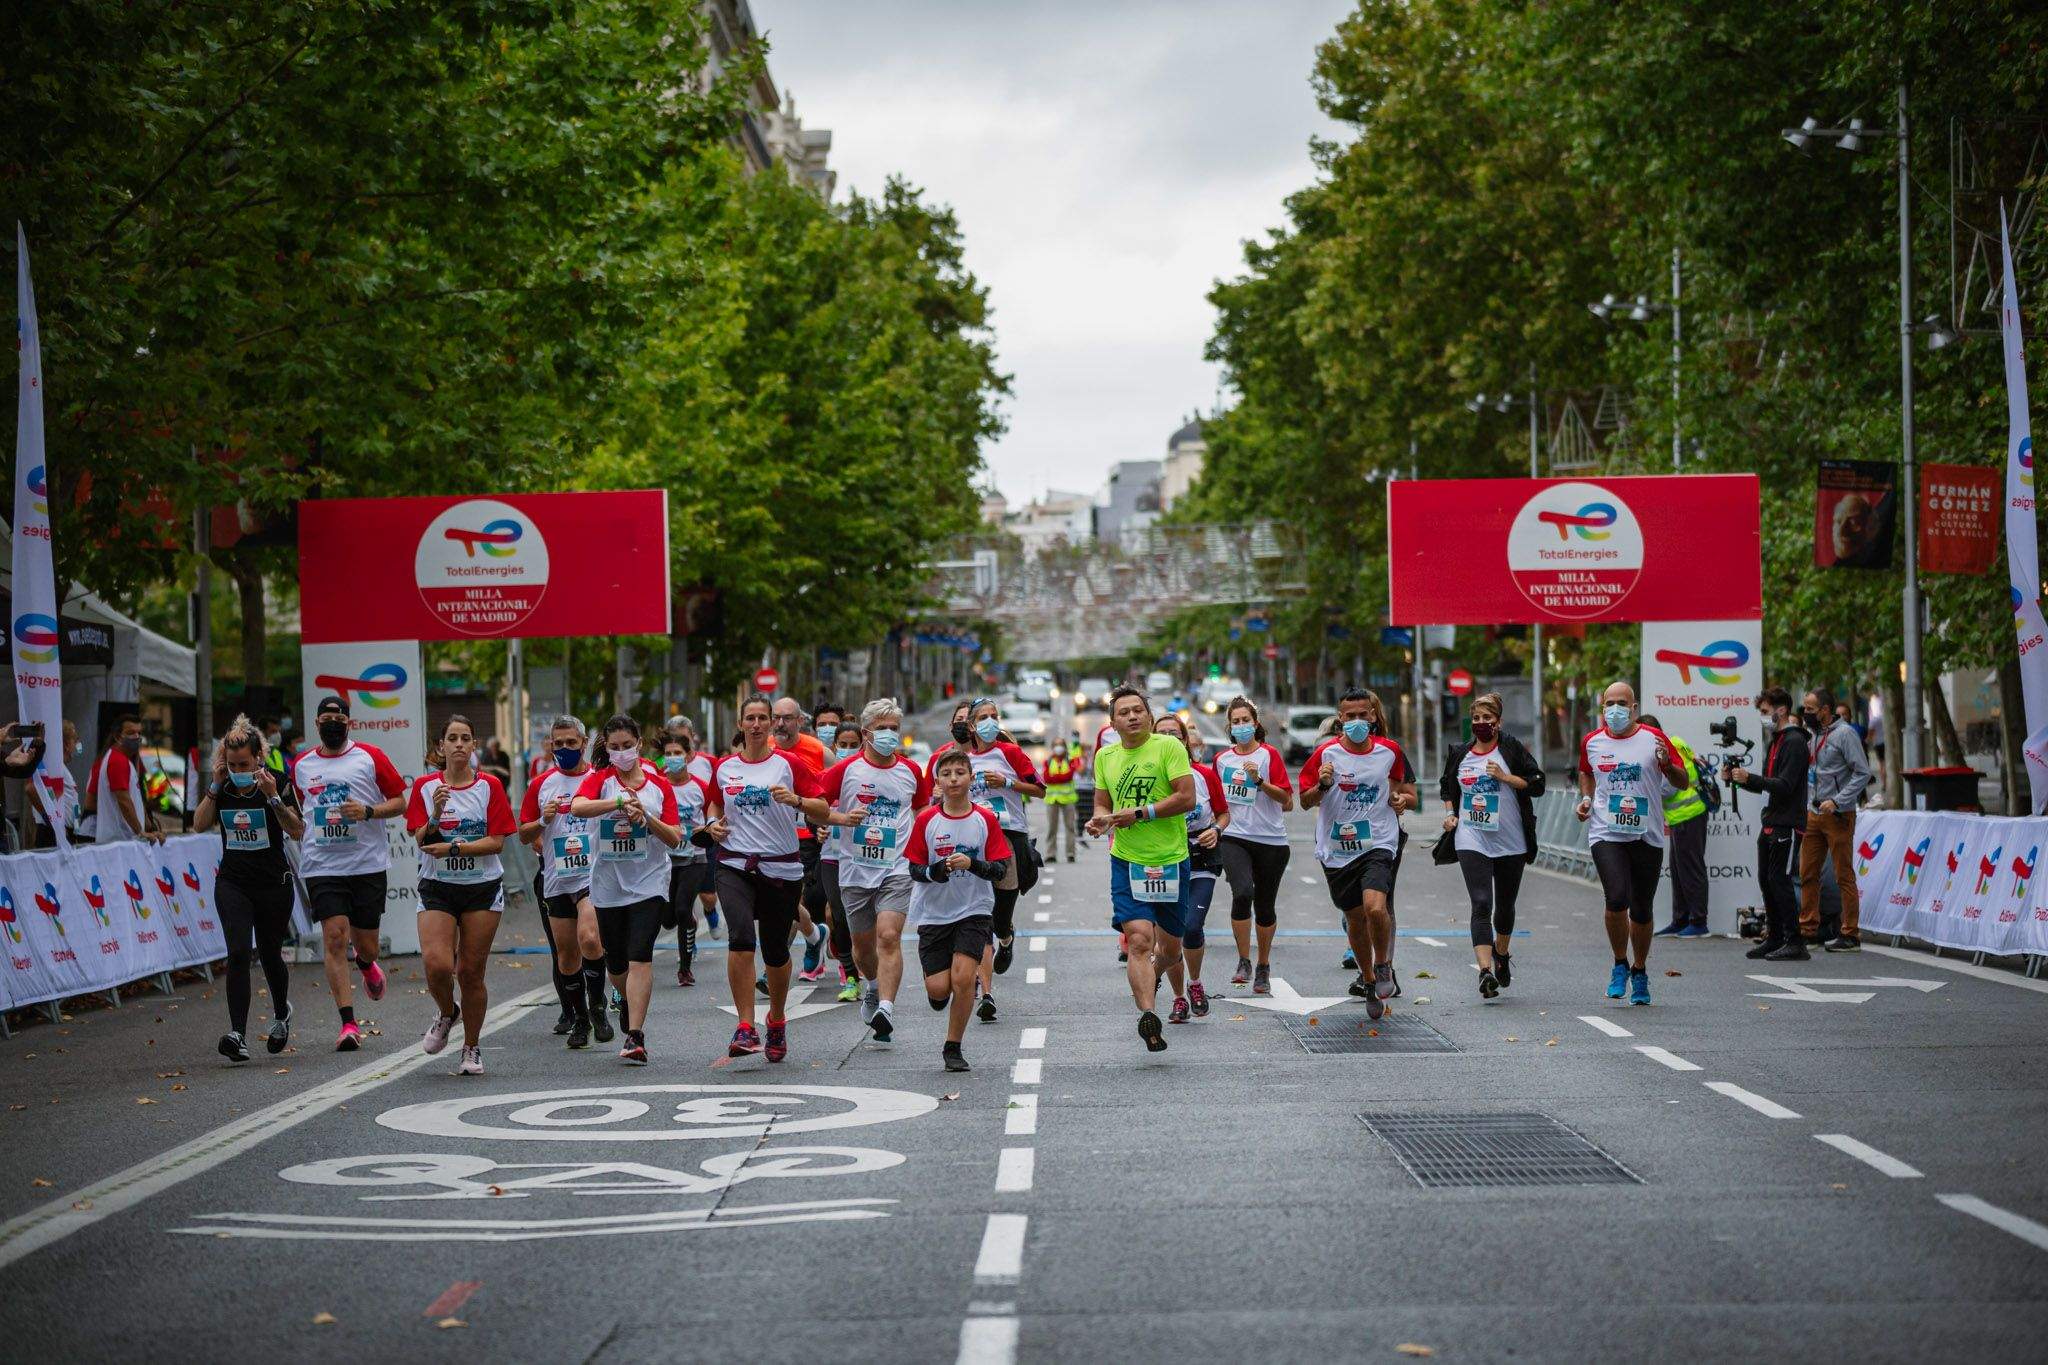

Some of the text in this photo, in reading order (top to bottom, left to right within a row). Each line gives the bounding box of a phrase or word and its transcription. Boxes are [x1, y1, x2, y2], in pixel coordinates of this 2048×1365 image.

[1538, 549, 1619, 561] TotalEnergies
[445, 565, 525, 577] TotalEnergies
[1558, 572, 1596, 583] MILLA
[465, 589, 502, 600] MILLA
[1544, 595, 1610, 607] DE MADRID
[452, 611, 517, 624] DE MADRID
[1655, 694, 1750, 709] TotalEnergies
[350, 717, 410, 732] Energies
[1227, 784, 1248, 798] 1140
[1469, 811, 1491, 824] 1082
[1615, 813, 1641, 827] 1059
[234, 829, 258, 842] 1136
[322, 825, 349, 838] 1002
[611, 839, 636, 852] 1118
[861, 845, 885, 859] 1131
[1340, 840, 1362, 851] 1141
[445, 857, 475, 871] 1003
[563, 854, 589, 869] 1148
[1143, 880, 1167, 893] 1111
[508, 1096, 808, 1126] 30
